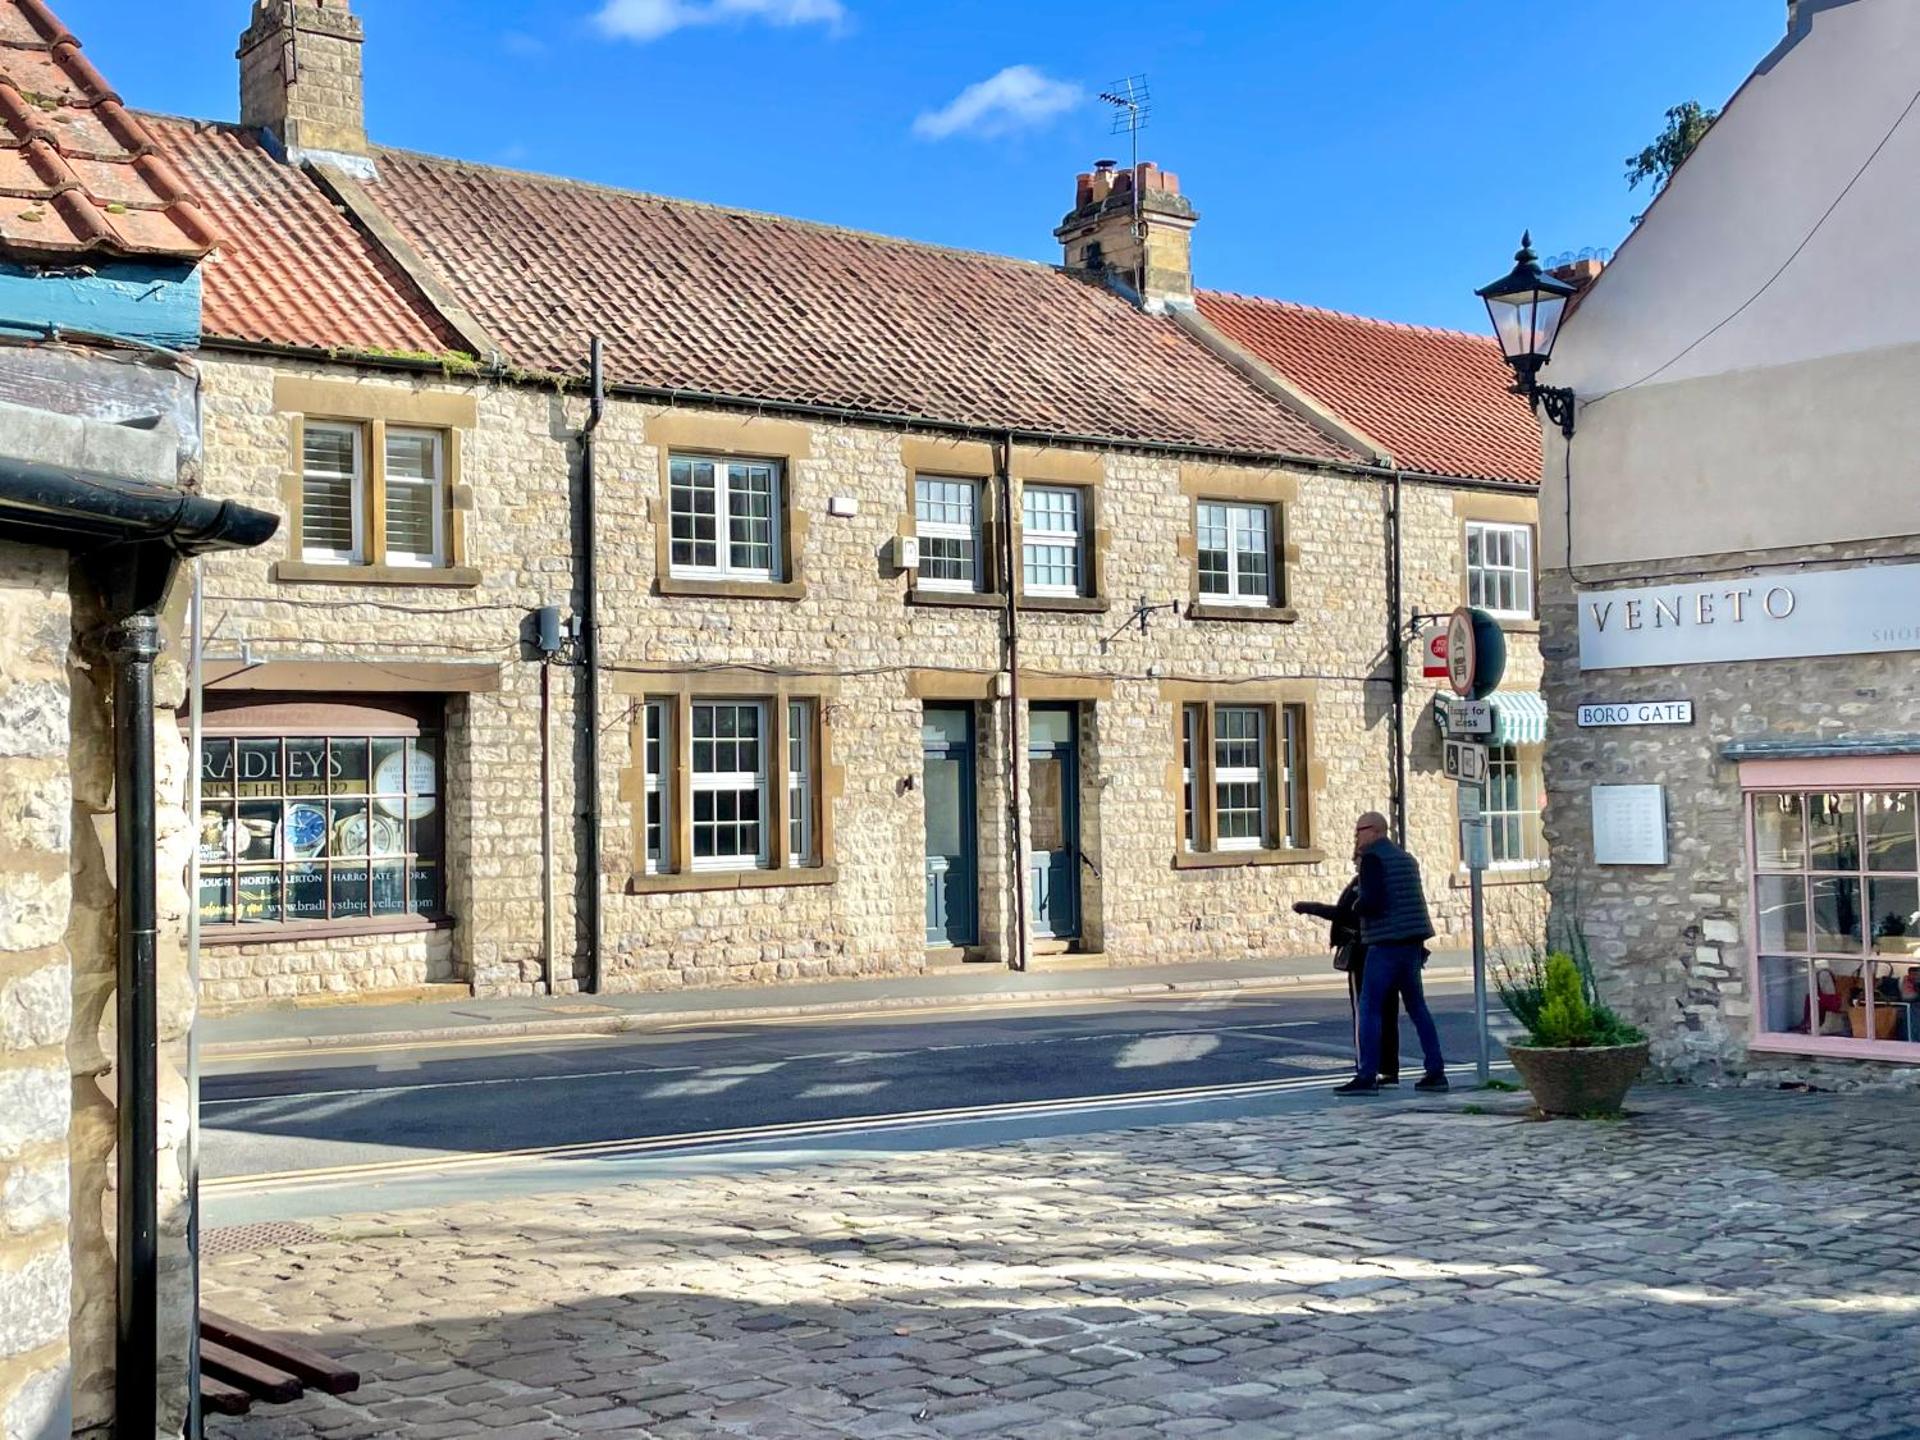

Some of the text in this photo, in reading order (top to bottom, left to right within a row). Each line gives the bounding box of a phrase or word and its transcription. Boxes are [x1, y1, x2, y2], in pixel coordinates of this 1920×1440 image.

[1590, 586, 1796, 633] VENETO
[1472, 706, 1485, 715] for
[1584, 705, 1686, 723] BORO GATE
[240, 874, 323, 886] NORTHALERTON
[333, 872, 392, 882] HARROATE
